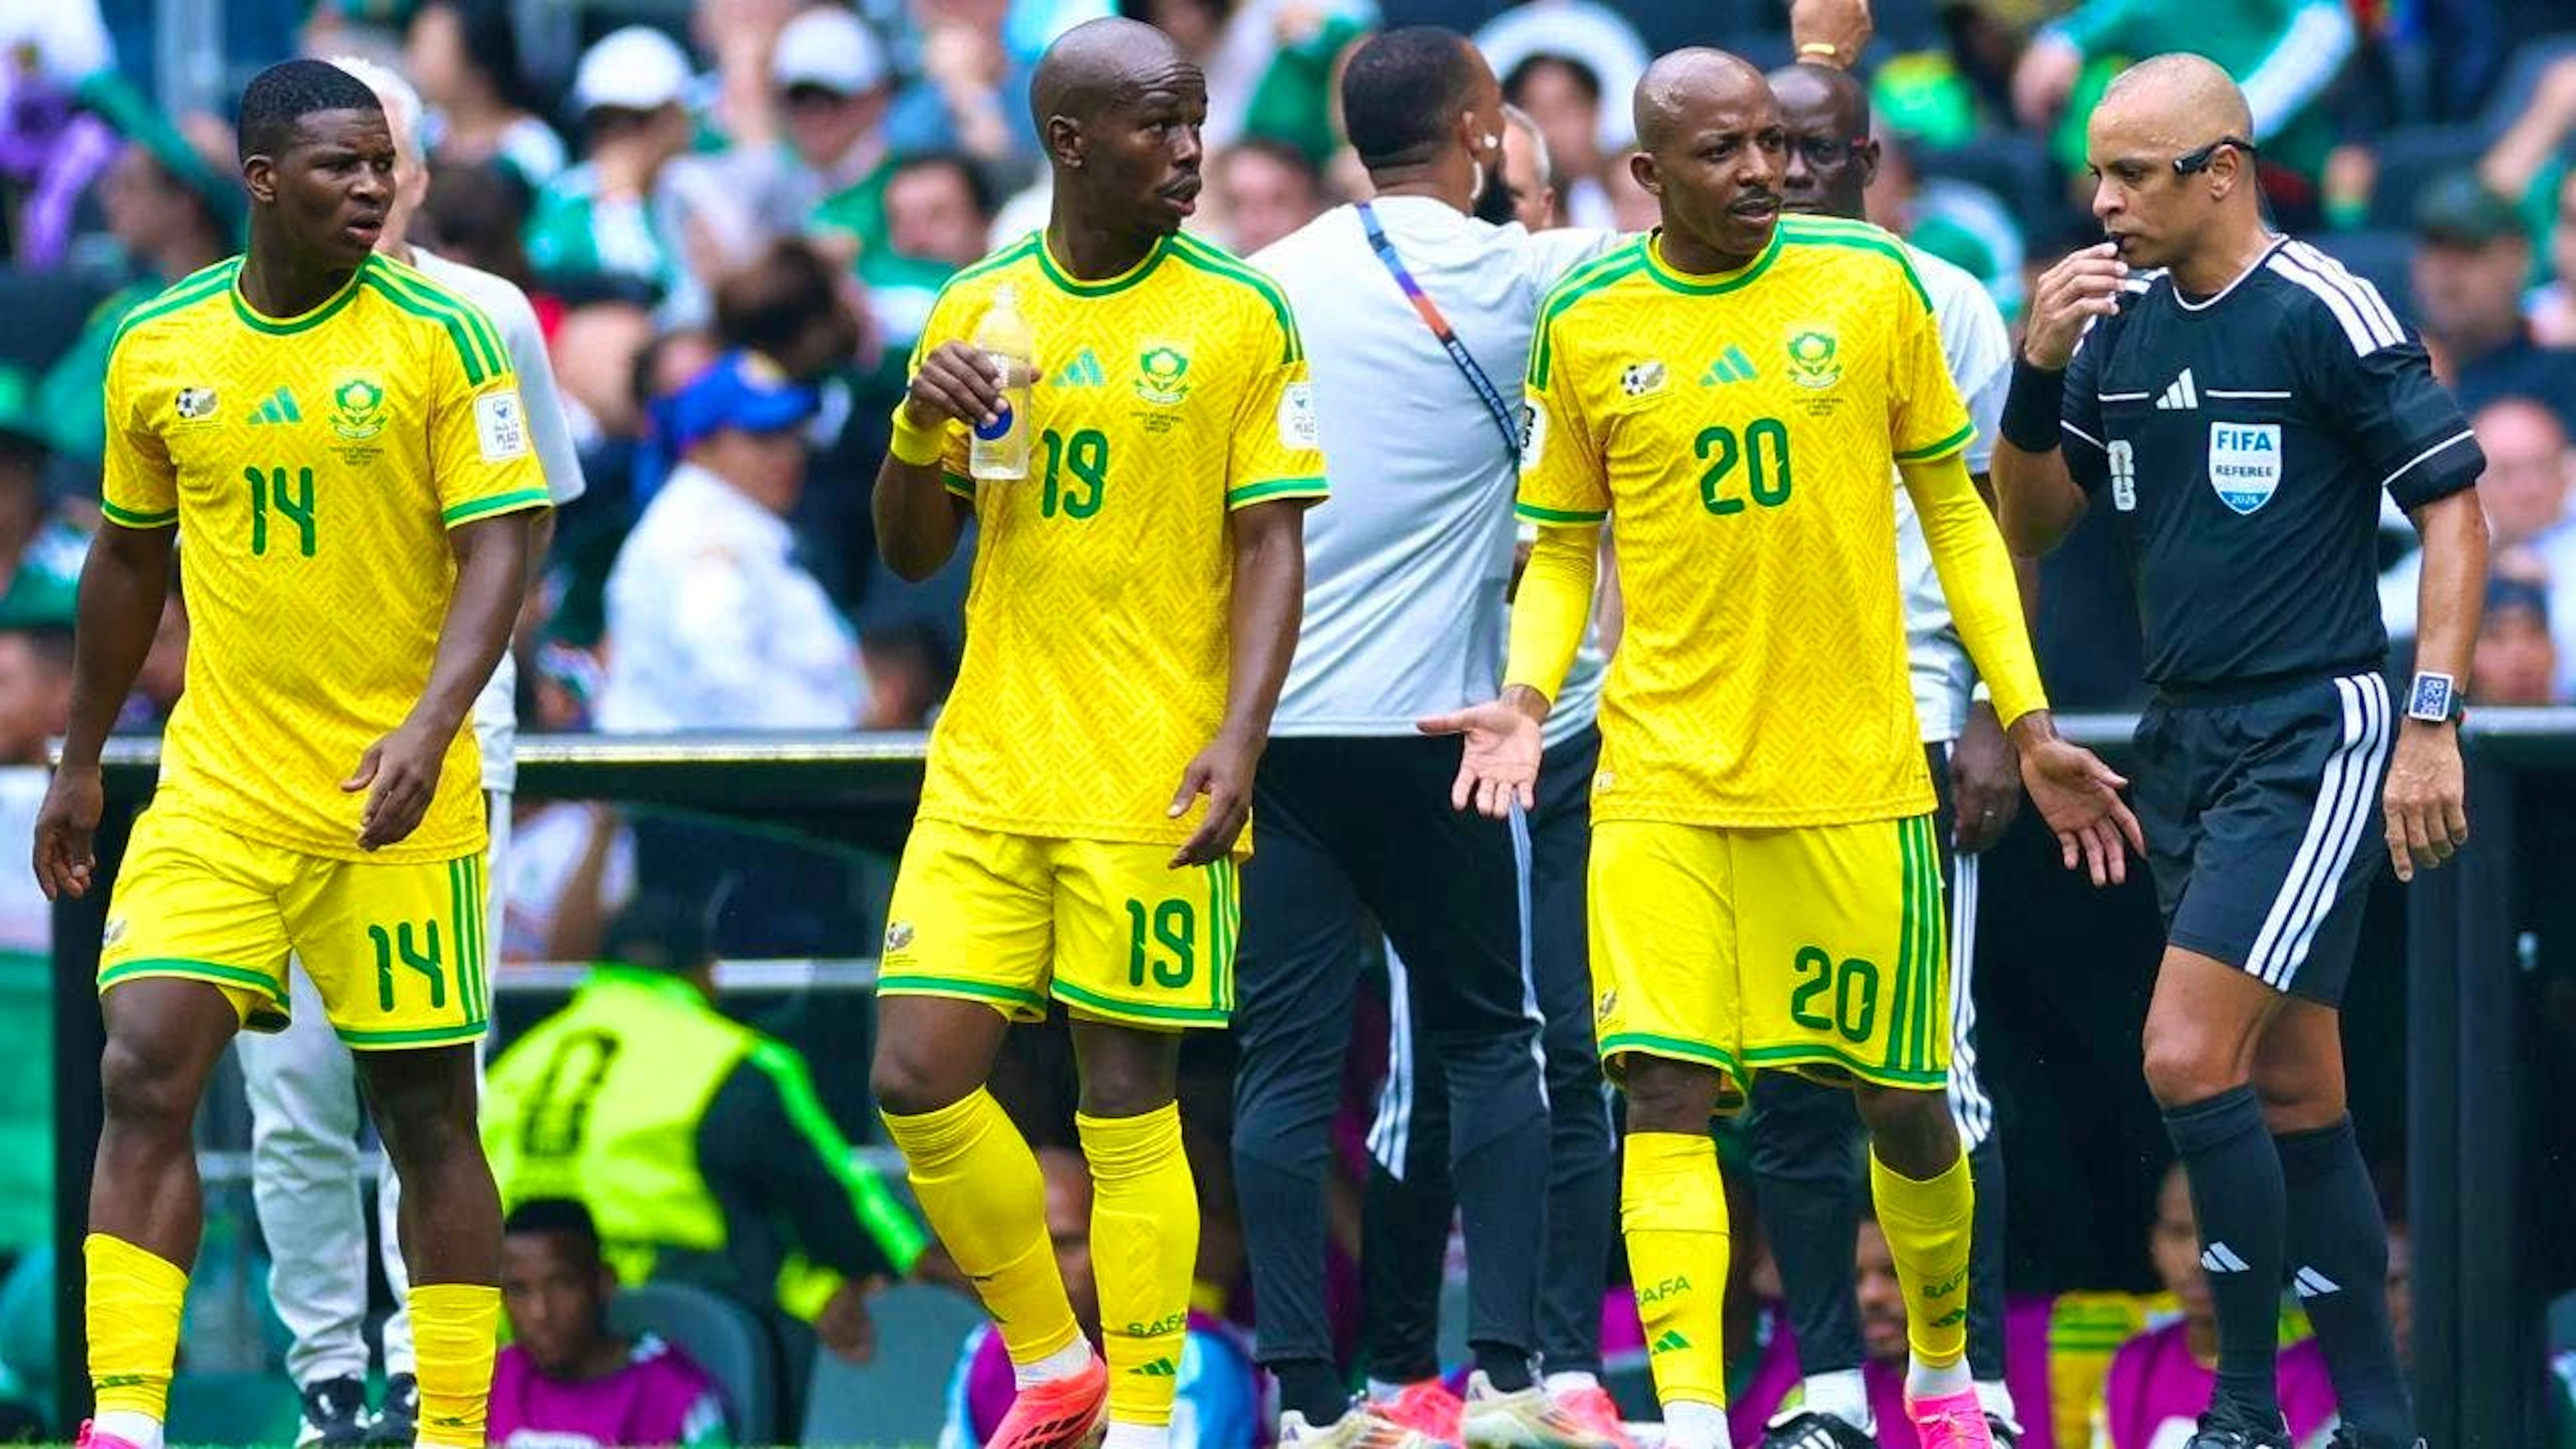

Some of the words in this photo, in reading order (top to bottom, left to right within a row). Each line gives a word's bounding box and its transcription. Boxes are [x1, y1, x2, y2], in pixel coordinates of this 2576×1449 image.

[1041, 429, 1109, 519] 19
[1695, 418, 1792, 515] 20
[2215, 464, 2274, 477] REFEREE
[2216, 430, 2273, 451] FIFA
[244, 466, 316, 557] 14
[368, 920, 445, 1012] 14
[1126, 899, 1195, 989] 19
[1790, 946, 1880, 1044] 20
[1637, 1276, 1691, 1305] AFA
